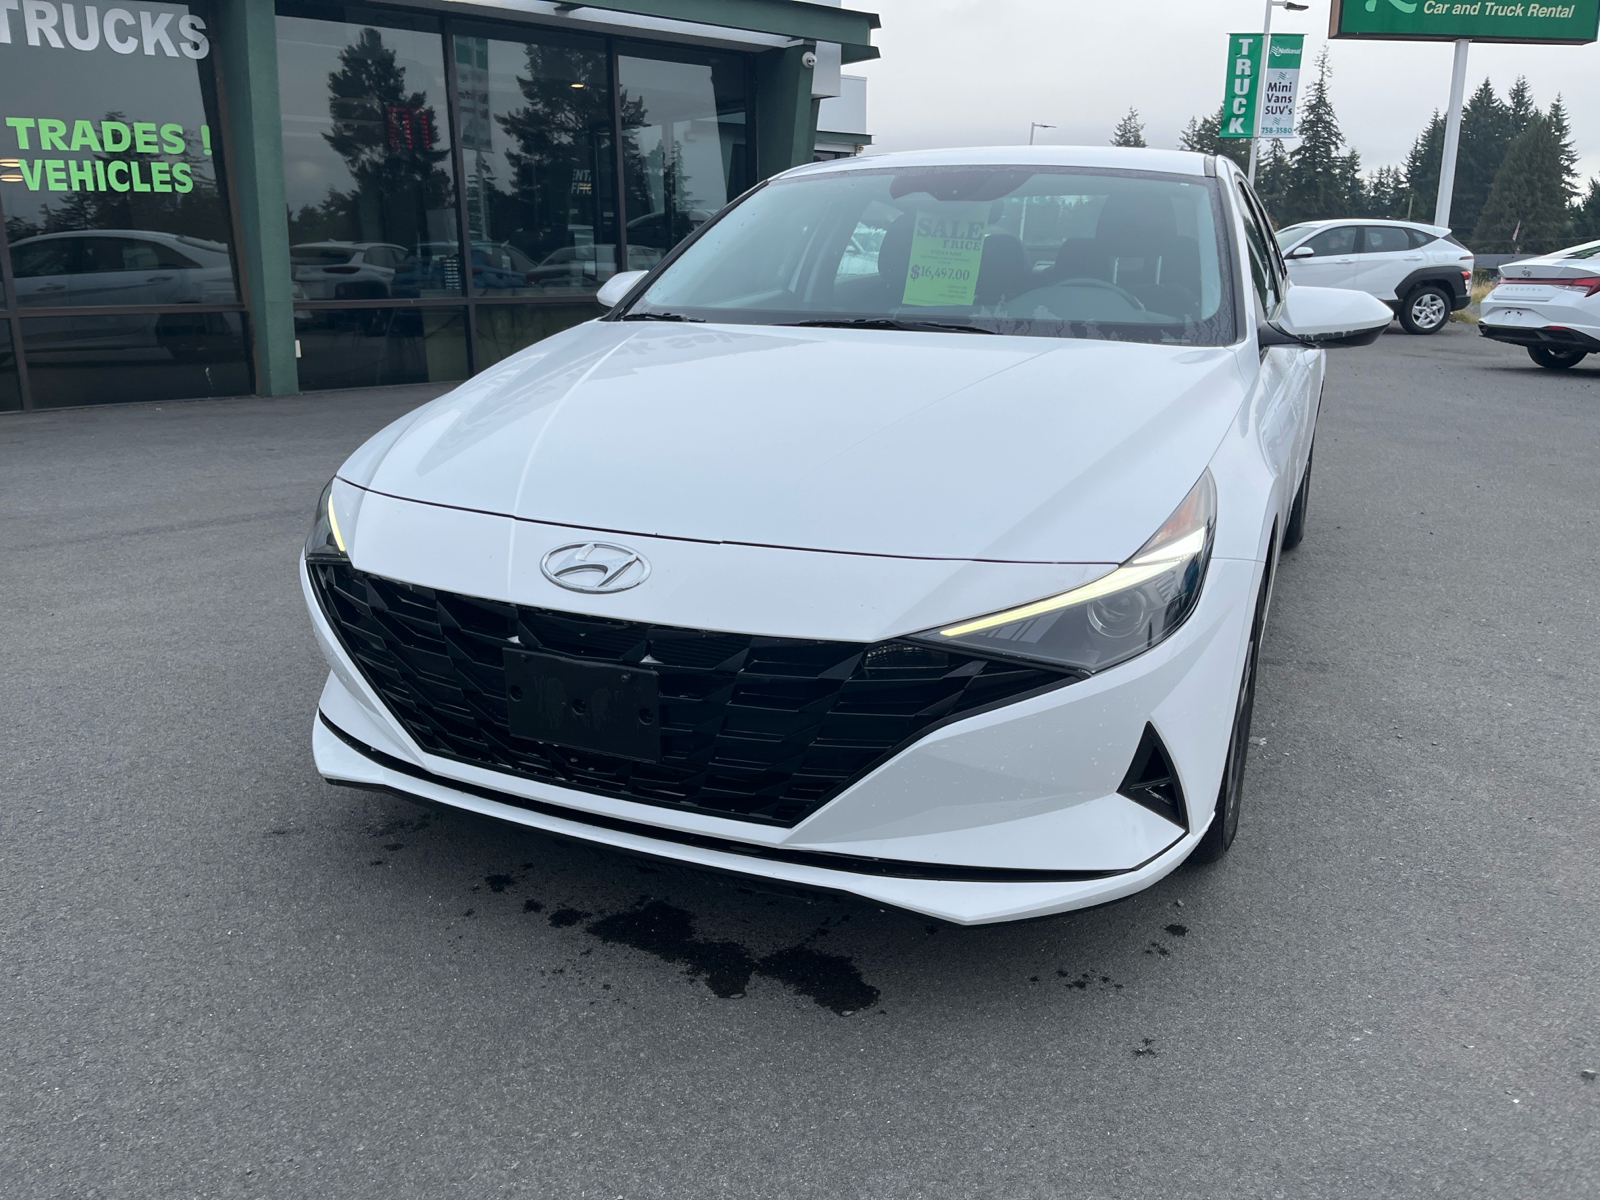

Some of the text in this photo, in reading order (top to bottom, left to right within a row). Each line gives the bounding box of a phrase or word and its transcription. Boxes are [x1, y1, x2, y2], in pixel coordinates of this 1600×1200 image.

[1423, 0, 1575, 18] Car and Truck Rental
[0, 0, 210, 60] TRUCKS
[1228, 38, 1254, 134] TRUCK
[1267, 81, 1293, 93] Mini
[1266, 93, 1293, 104] Vans
[1265, 104, 1293, 115] SUV's
[5, 116, 186, 155] TRADES
[1261, 126, 1293, 134] 758-3580
[18, 158, 194, 194] VEHICLES
[916, 217, 985, 241] SALE
[941, 239, 982, 251] PRICE
[909, 263, 970, 282] $16,497.00
